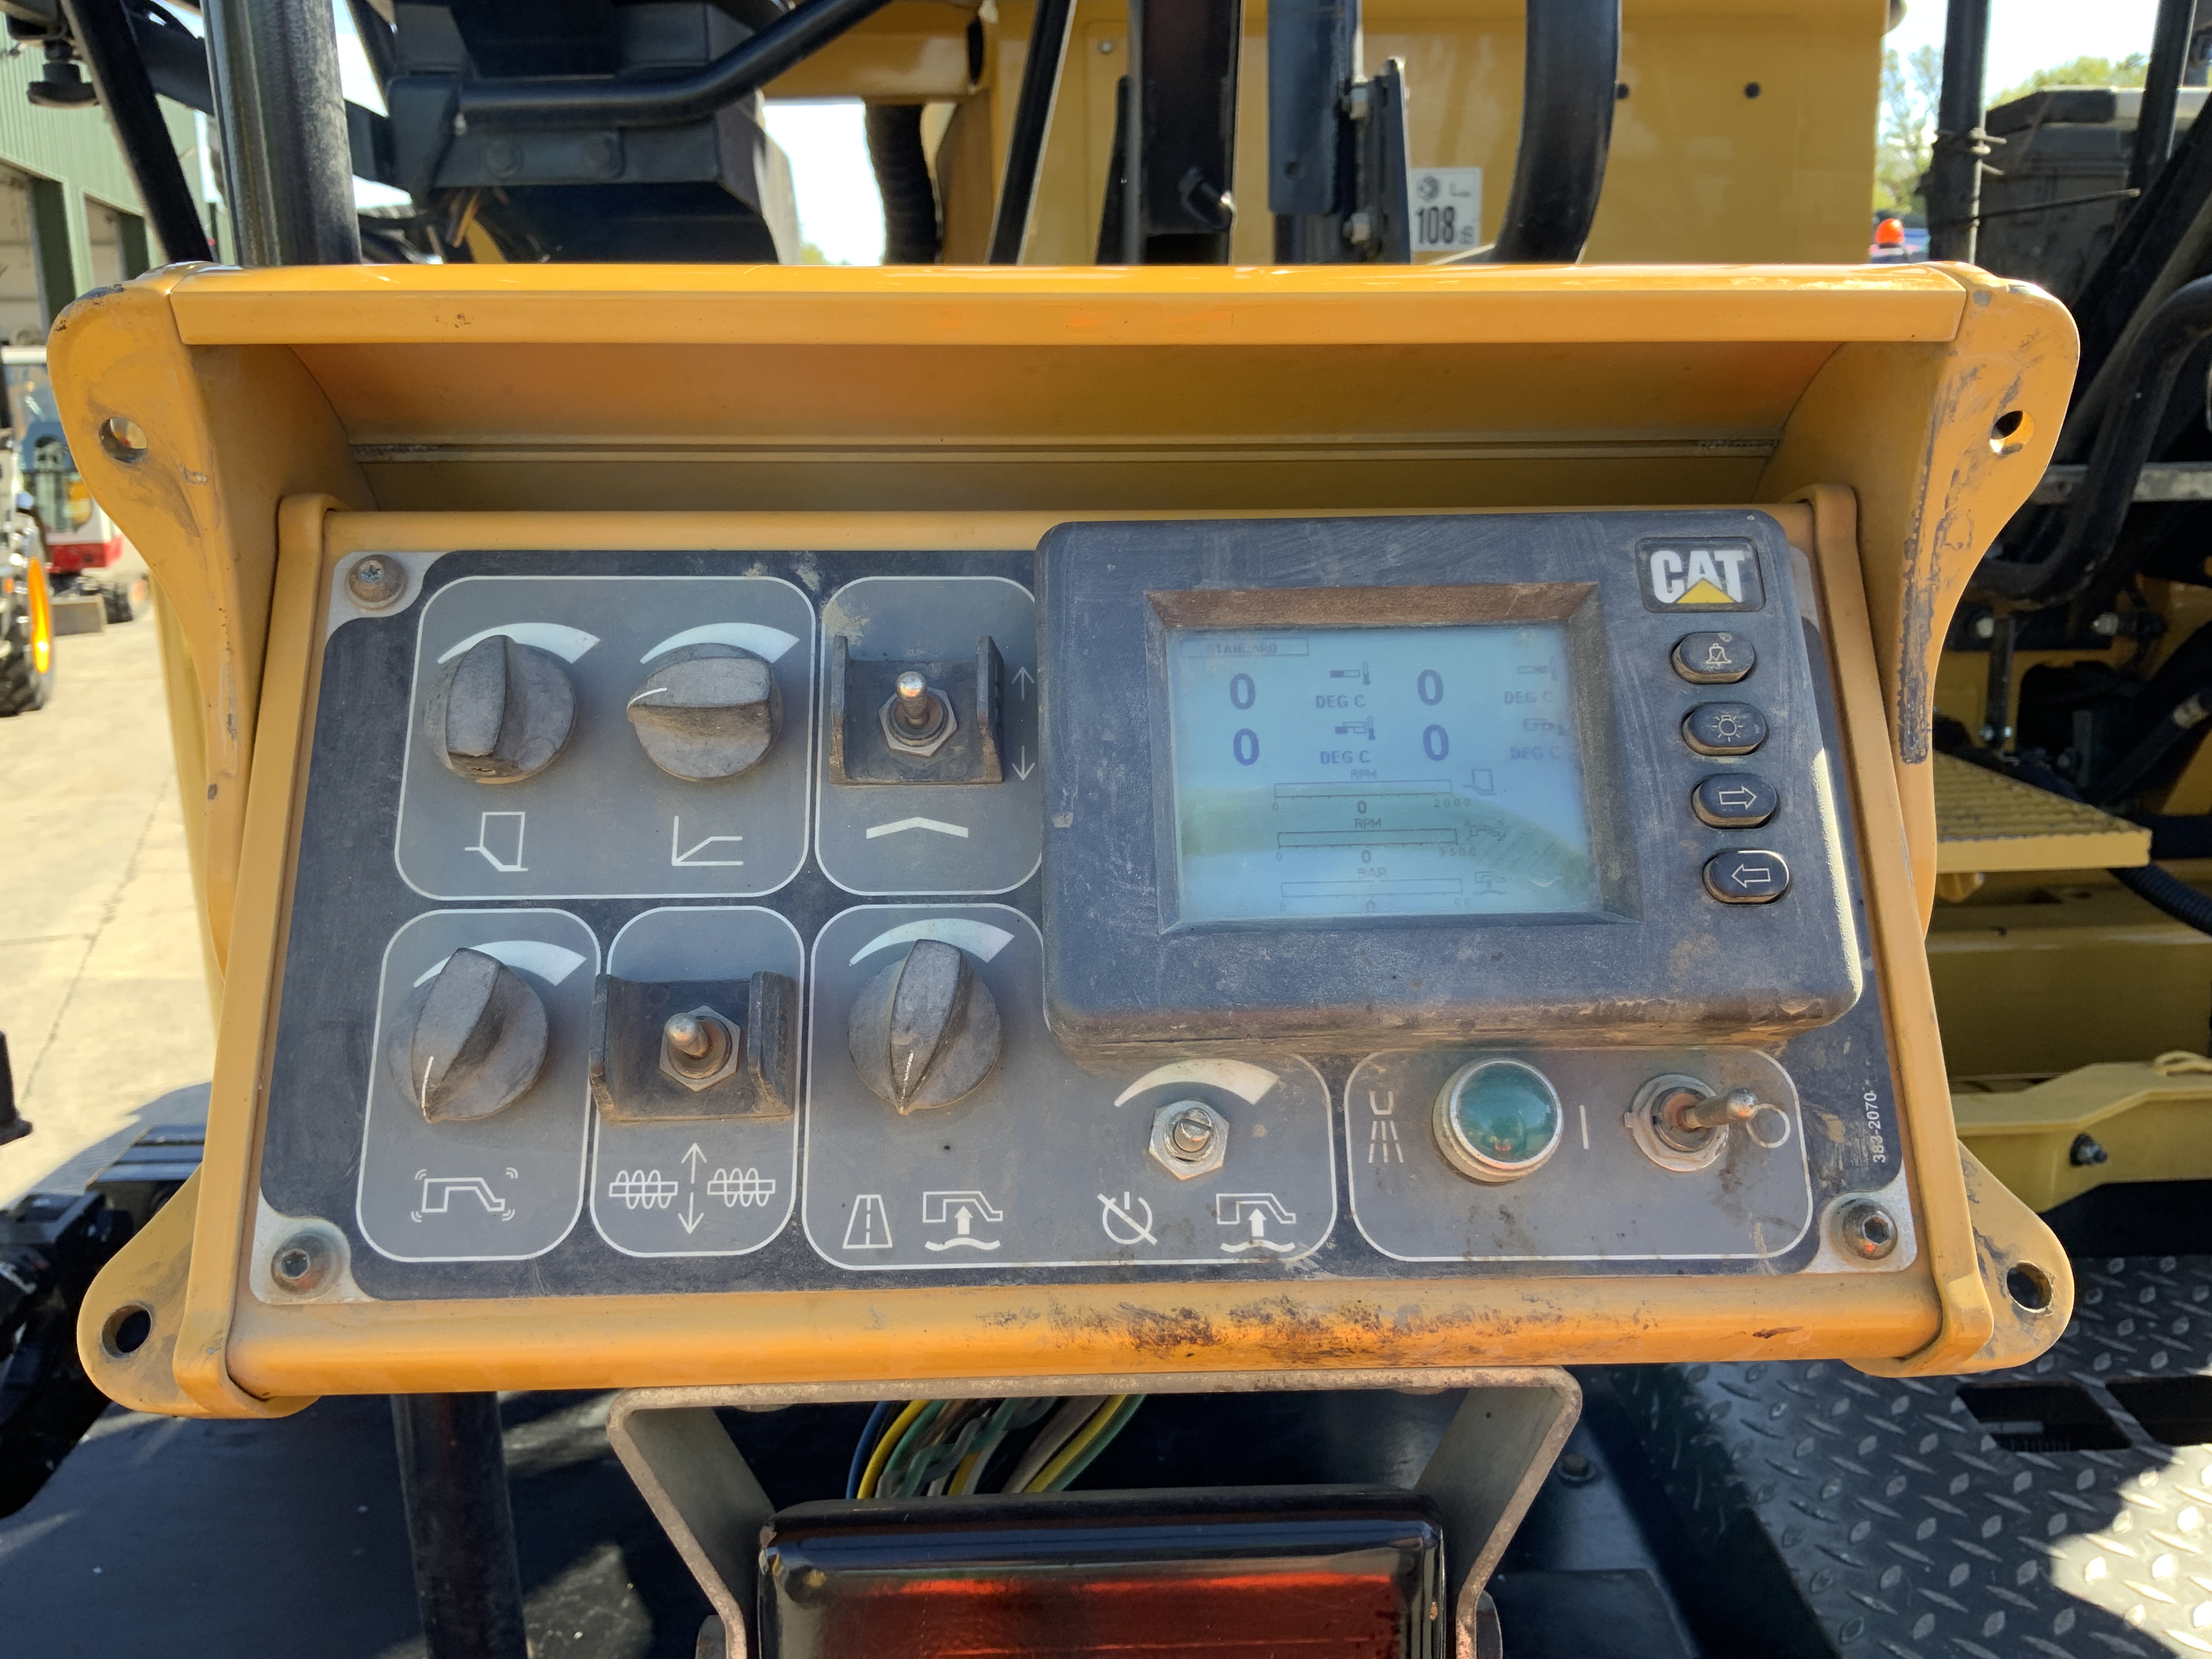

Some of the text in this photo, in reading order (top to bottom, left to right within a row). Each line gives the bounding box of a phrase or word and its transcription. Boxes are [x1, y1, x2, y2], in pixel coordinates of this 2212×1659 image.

[1415, 206, 1456, 245] 108
[1650, 550, 1745, 603] CAT
[1230, 673, 1256, 710] 0
[1417, 669, 1443, 706] 0
[1316, 695, 1365, 708] DEG C
[1504, 690, 1553, 705] DEG C
[1233, 728, 1260, 766] 0
[1423, 724, 1449, 761] 0
[1319, 750, 1370, 764] DEG C
[1351, 769, 1377, 780] RPM
[1357, 800, 1367, 814] 0
[1434, 798, 1470, 808] 2000
[1355, 817, 1381, 828] RPM
[1361, 849, 1372, 864] 0
[1357, 867, 1388, 878] BAR
[1864, 1092, 1886, 1163] 383-2070
